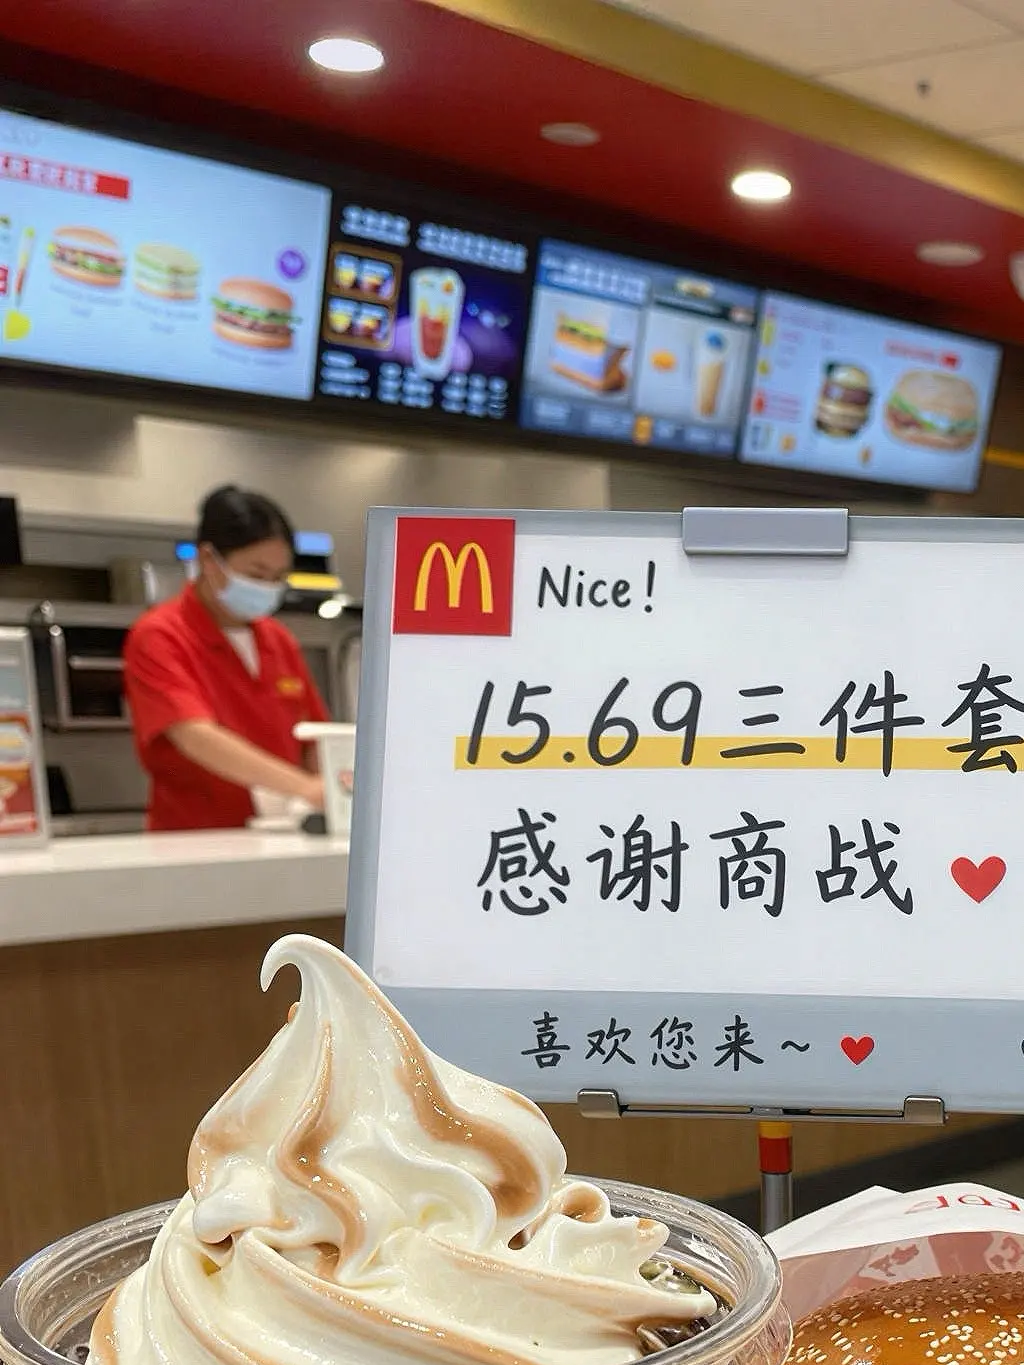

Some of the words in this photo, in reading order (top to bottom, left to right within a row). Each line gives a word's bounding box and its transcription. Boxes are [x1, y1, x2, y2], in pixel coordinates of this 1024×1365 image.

[538, 560, 656, 613] Nice!
[477, 807, 914, 918] 感谢商战
